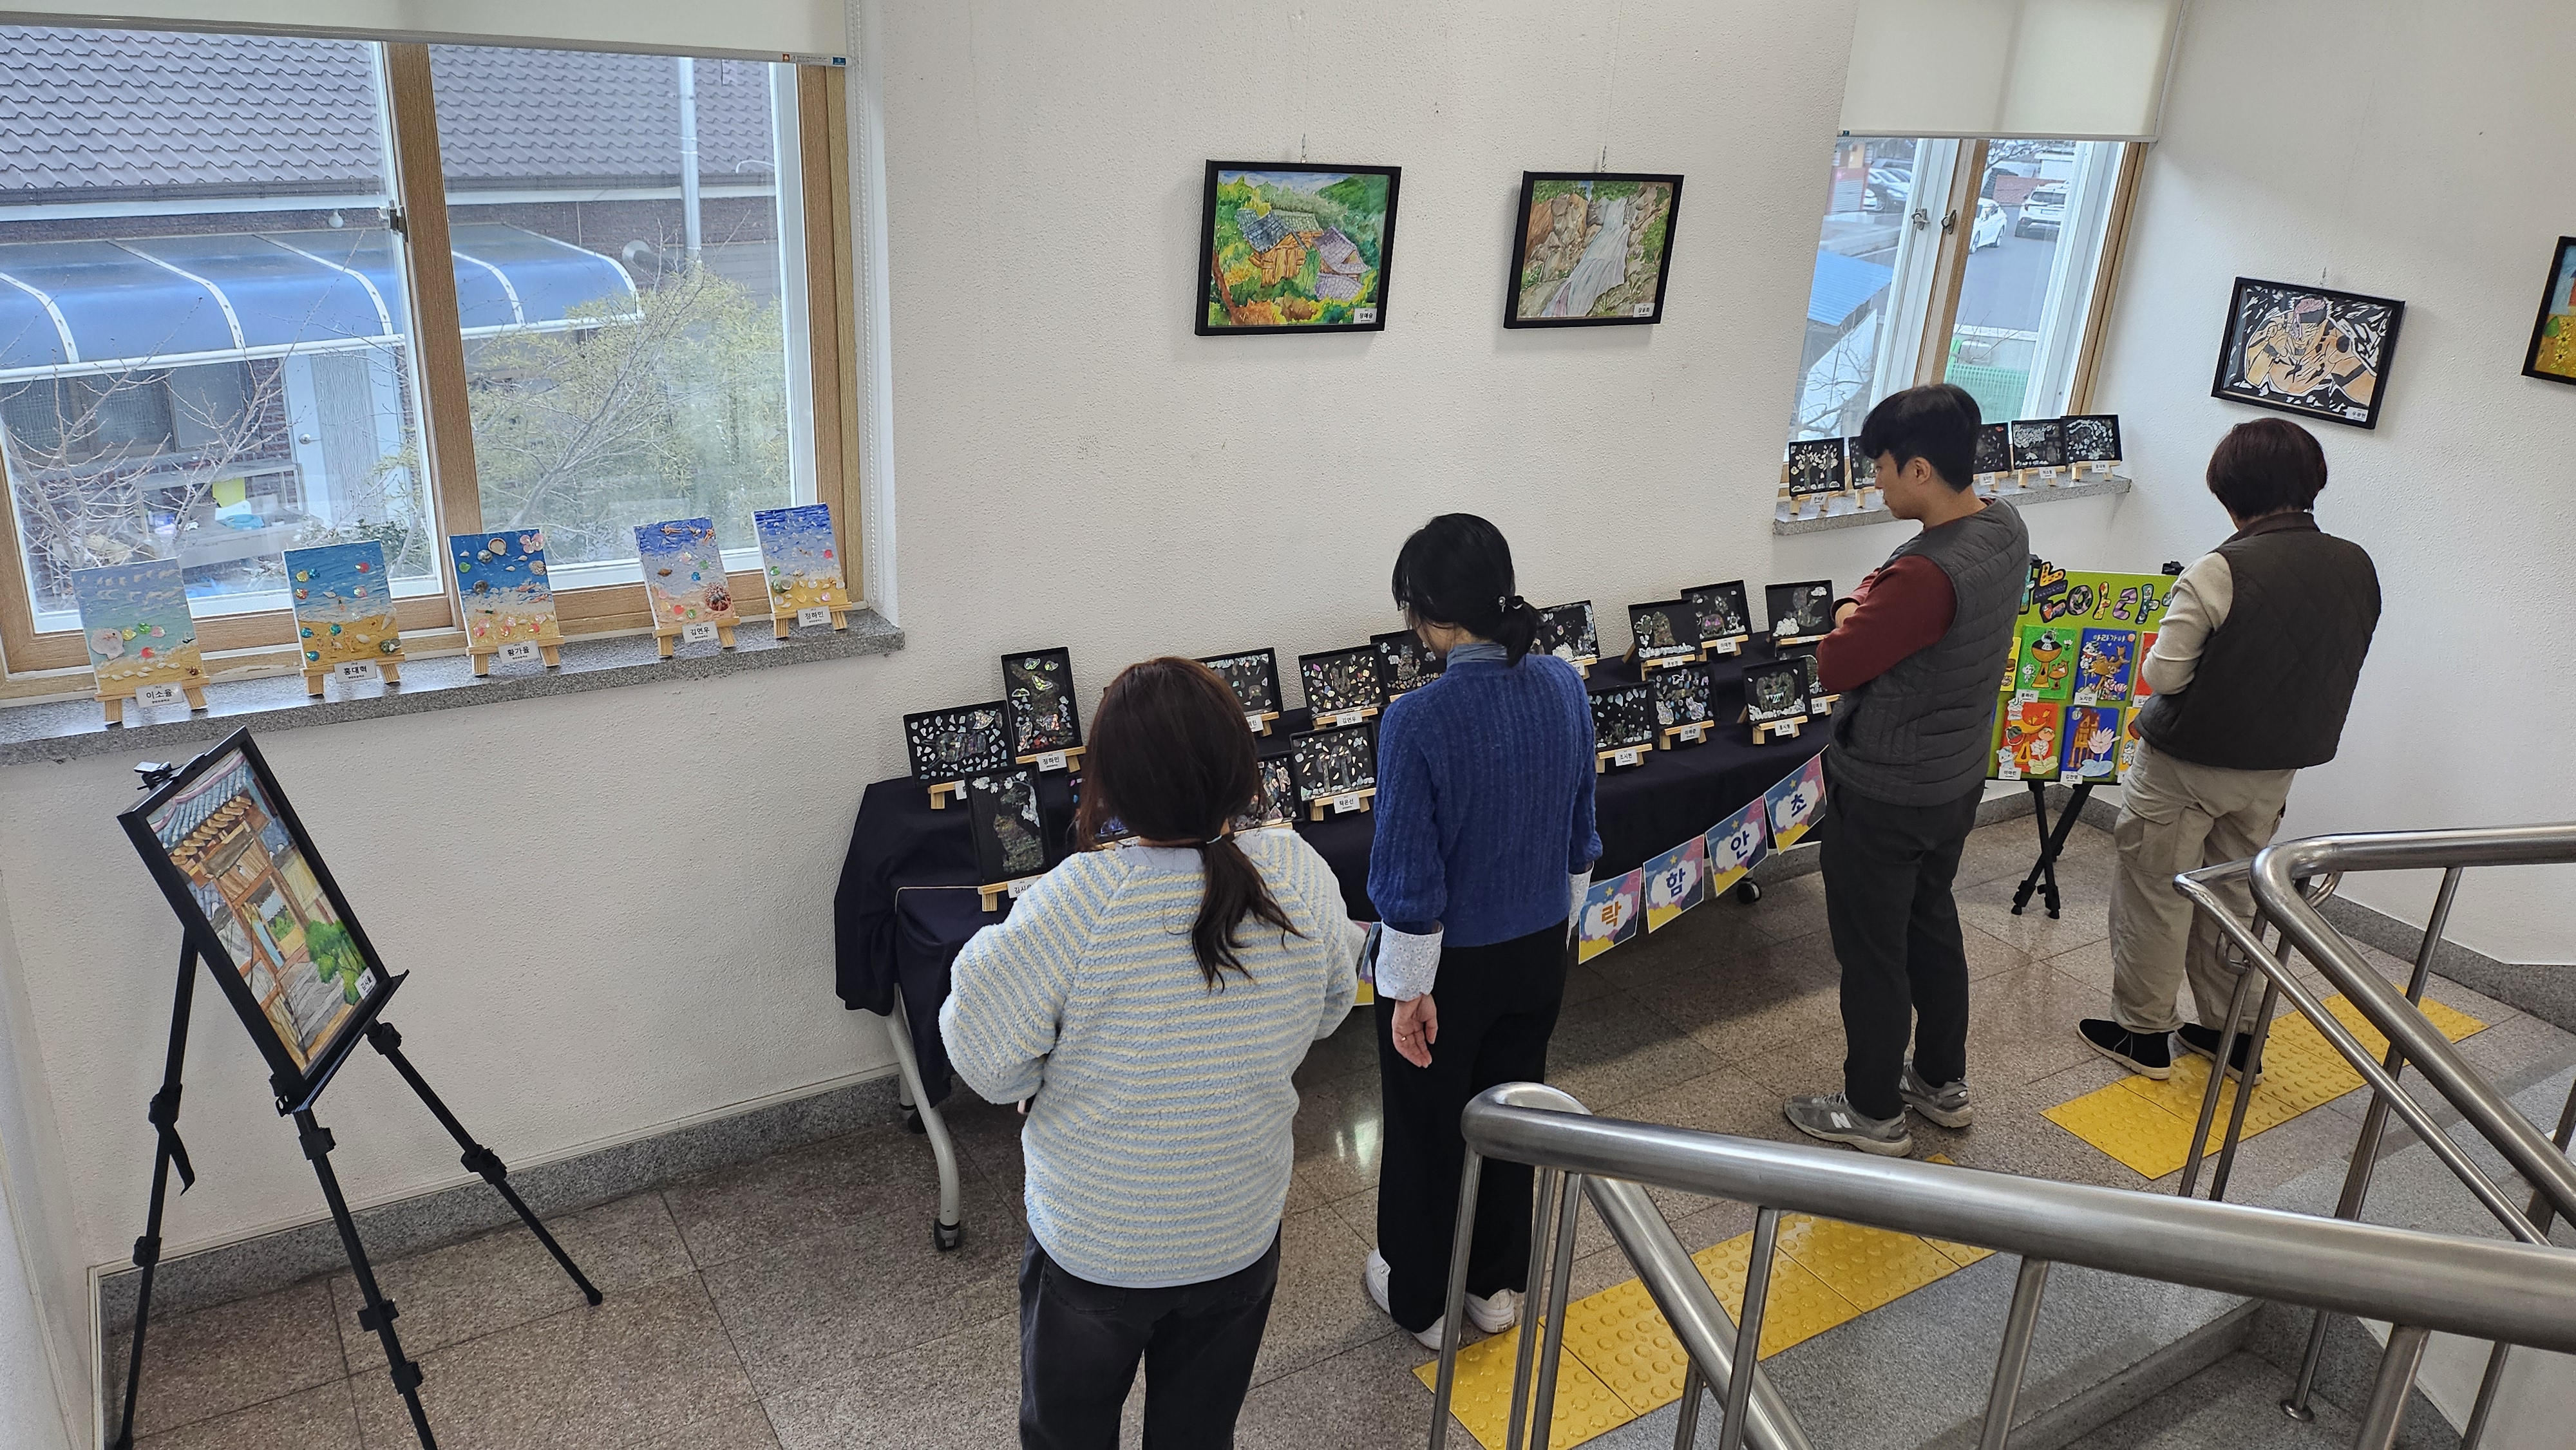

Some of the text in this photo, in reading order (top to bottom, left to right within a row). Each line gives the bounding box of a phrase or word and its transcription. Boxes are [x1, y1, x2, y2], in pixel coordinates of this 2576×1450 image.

[804, 610, 824, 620] 정하민
[690, 626, 710, 636] 김연우
[2092, 634, 2126, 643] 아라가야
[343, 665, 368, 675] 홍대혁
[1042, 756, 1060, 765] 정하민
[1601, 793, 1807, 927] 락 함 안 초
[1830, 1112, 1852, 1128] N
